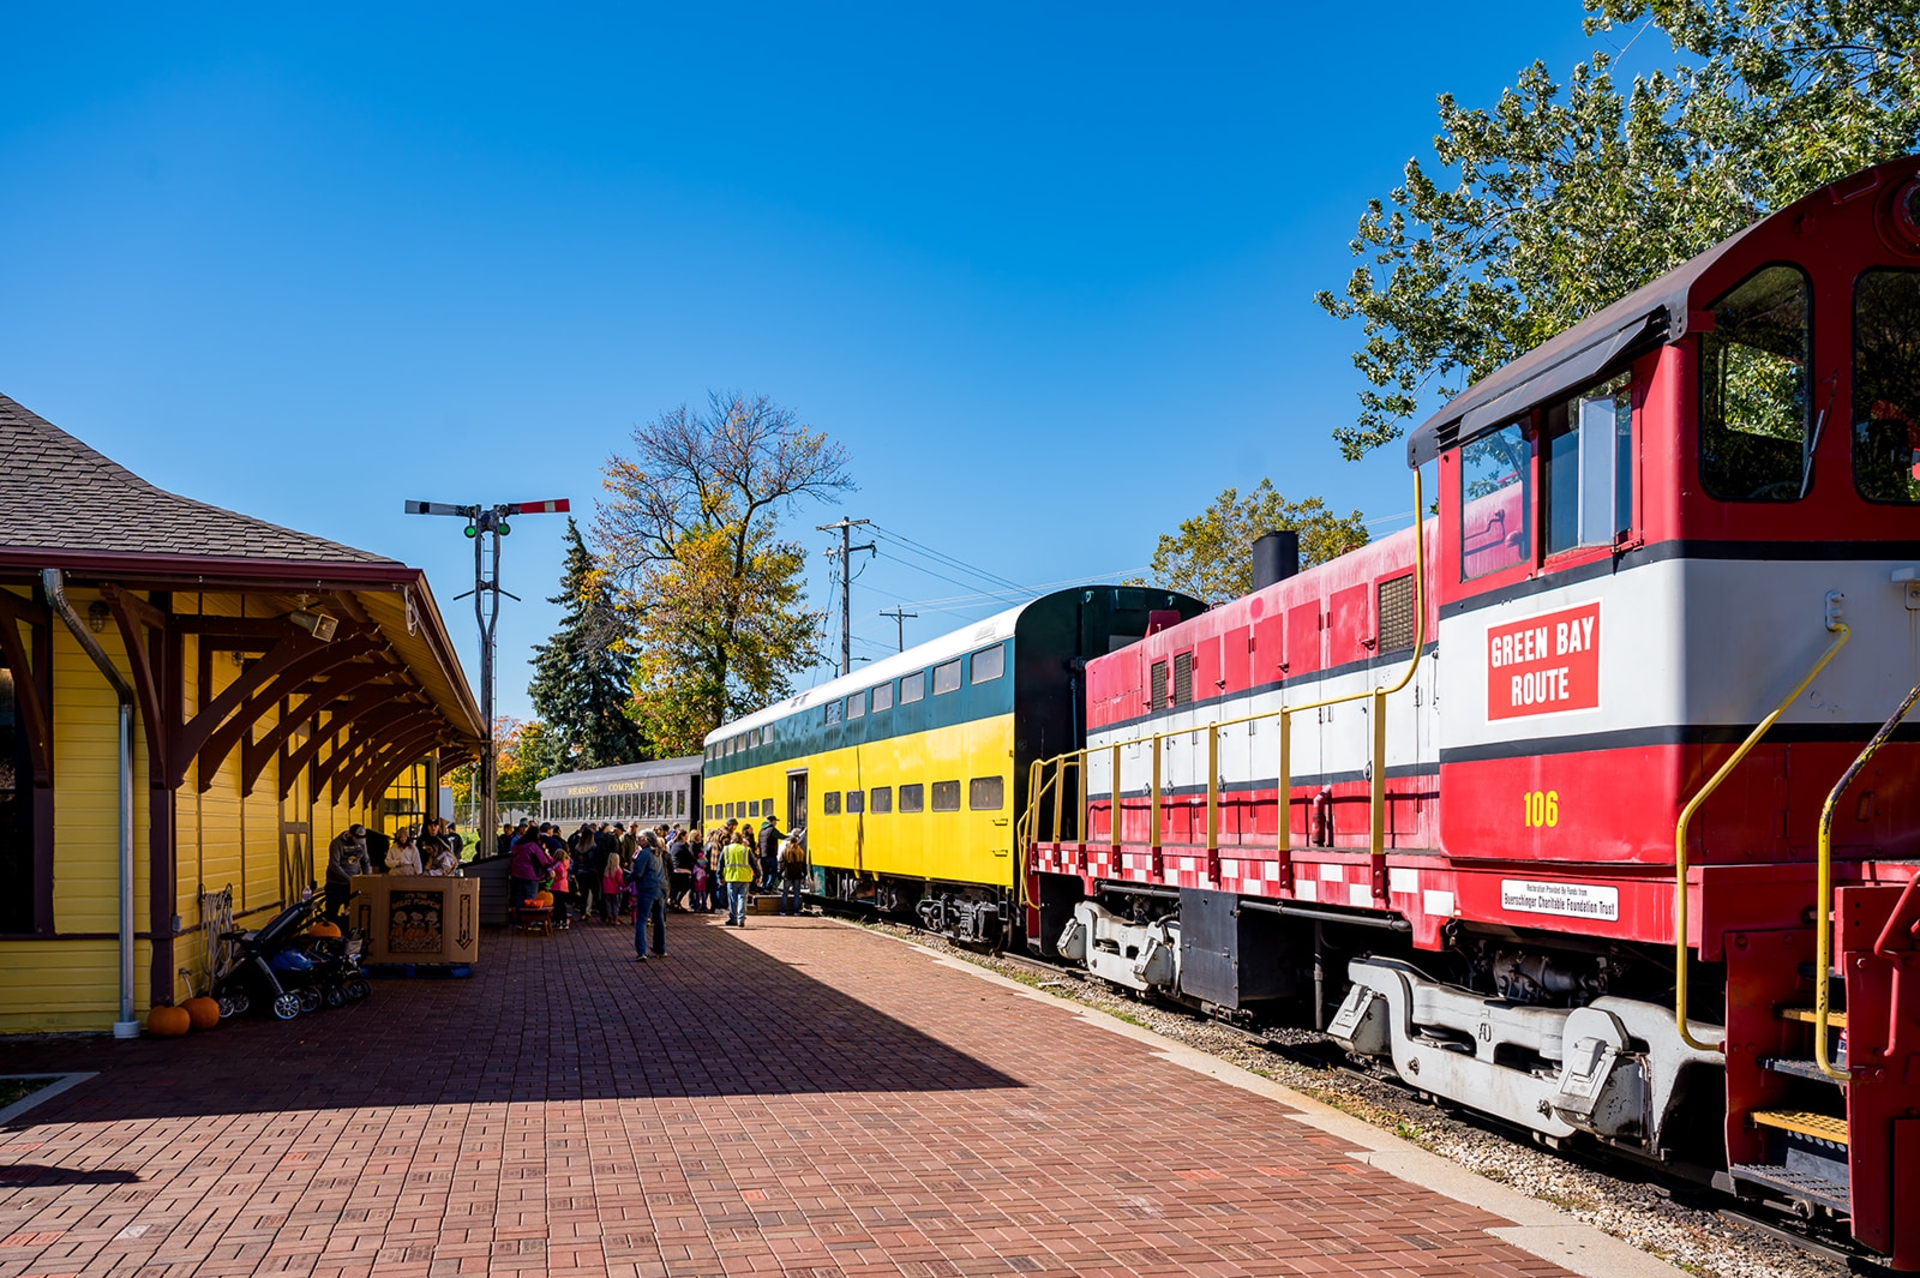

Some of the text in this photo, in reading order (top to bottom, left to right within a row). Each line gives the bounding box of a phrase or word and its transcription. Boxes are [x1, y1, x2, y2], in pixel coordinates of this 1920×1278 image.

[1491, 616, 1595, 668] GREEN BAY
[1511, 666, 1569, 707] ROUTE
[568, 781, 645, 795] READING COMPANY
[1523, 790, 1559, 828] 106
[1538, 895, 1565, 910] Charitable
[1566, 898, 1597, 913] Foundation
[1599, 900, 1615, 915] Trust
